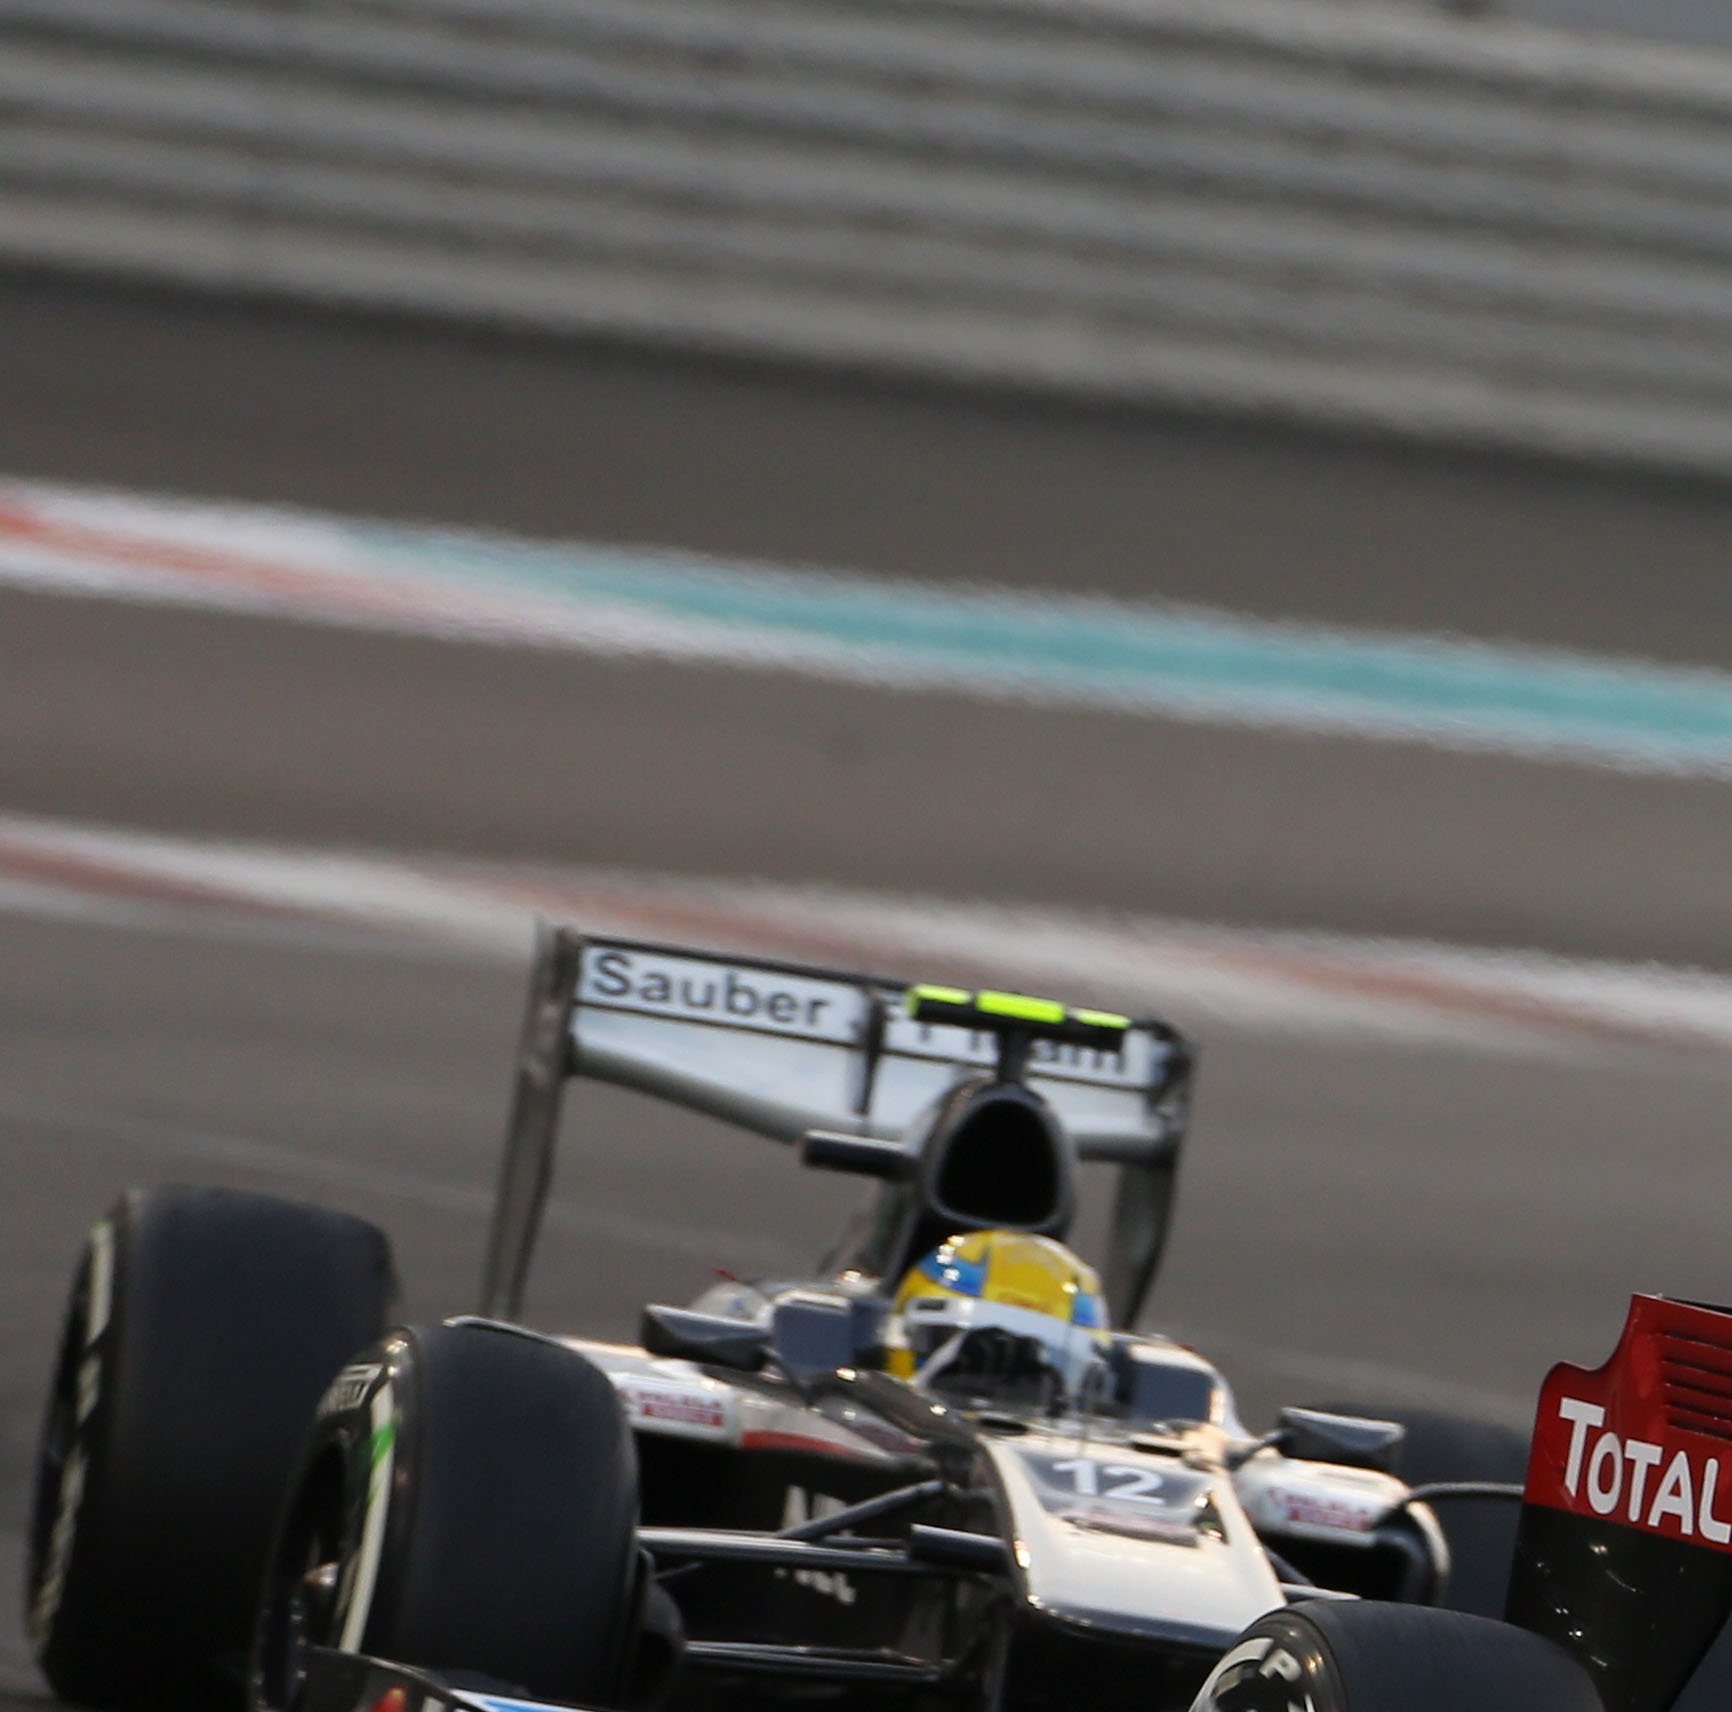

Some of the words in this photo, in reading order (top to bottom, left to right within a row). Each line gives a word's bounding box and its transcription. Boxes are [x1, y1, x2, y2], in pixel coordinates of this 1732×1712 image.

[591, 950, 829, 1028] Sauber
[1052, 1458, 1168, 1506] 12
[1559, 1395, 1732, 1545] TOTAL
